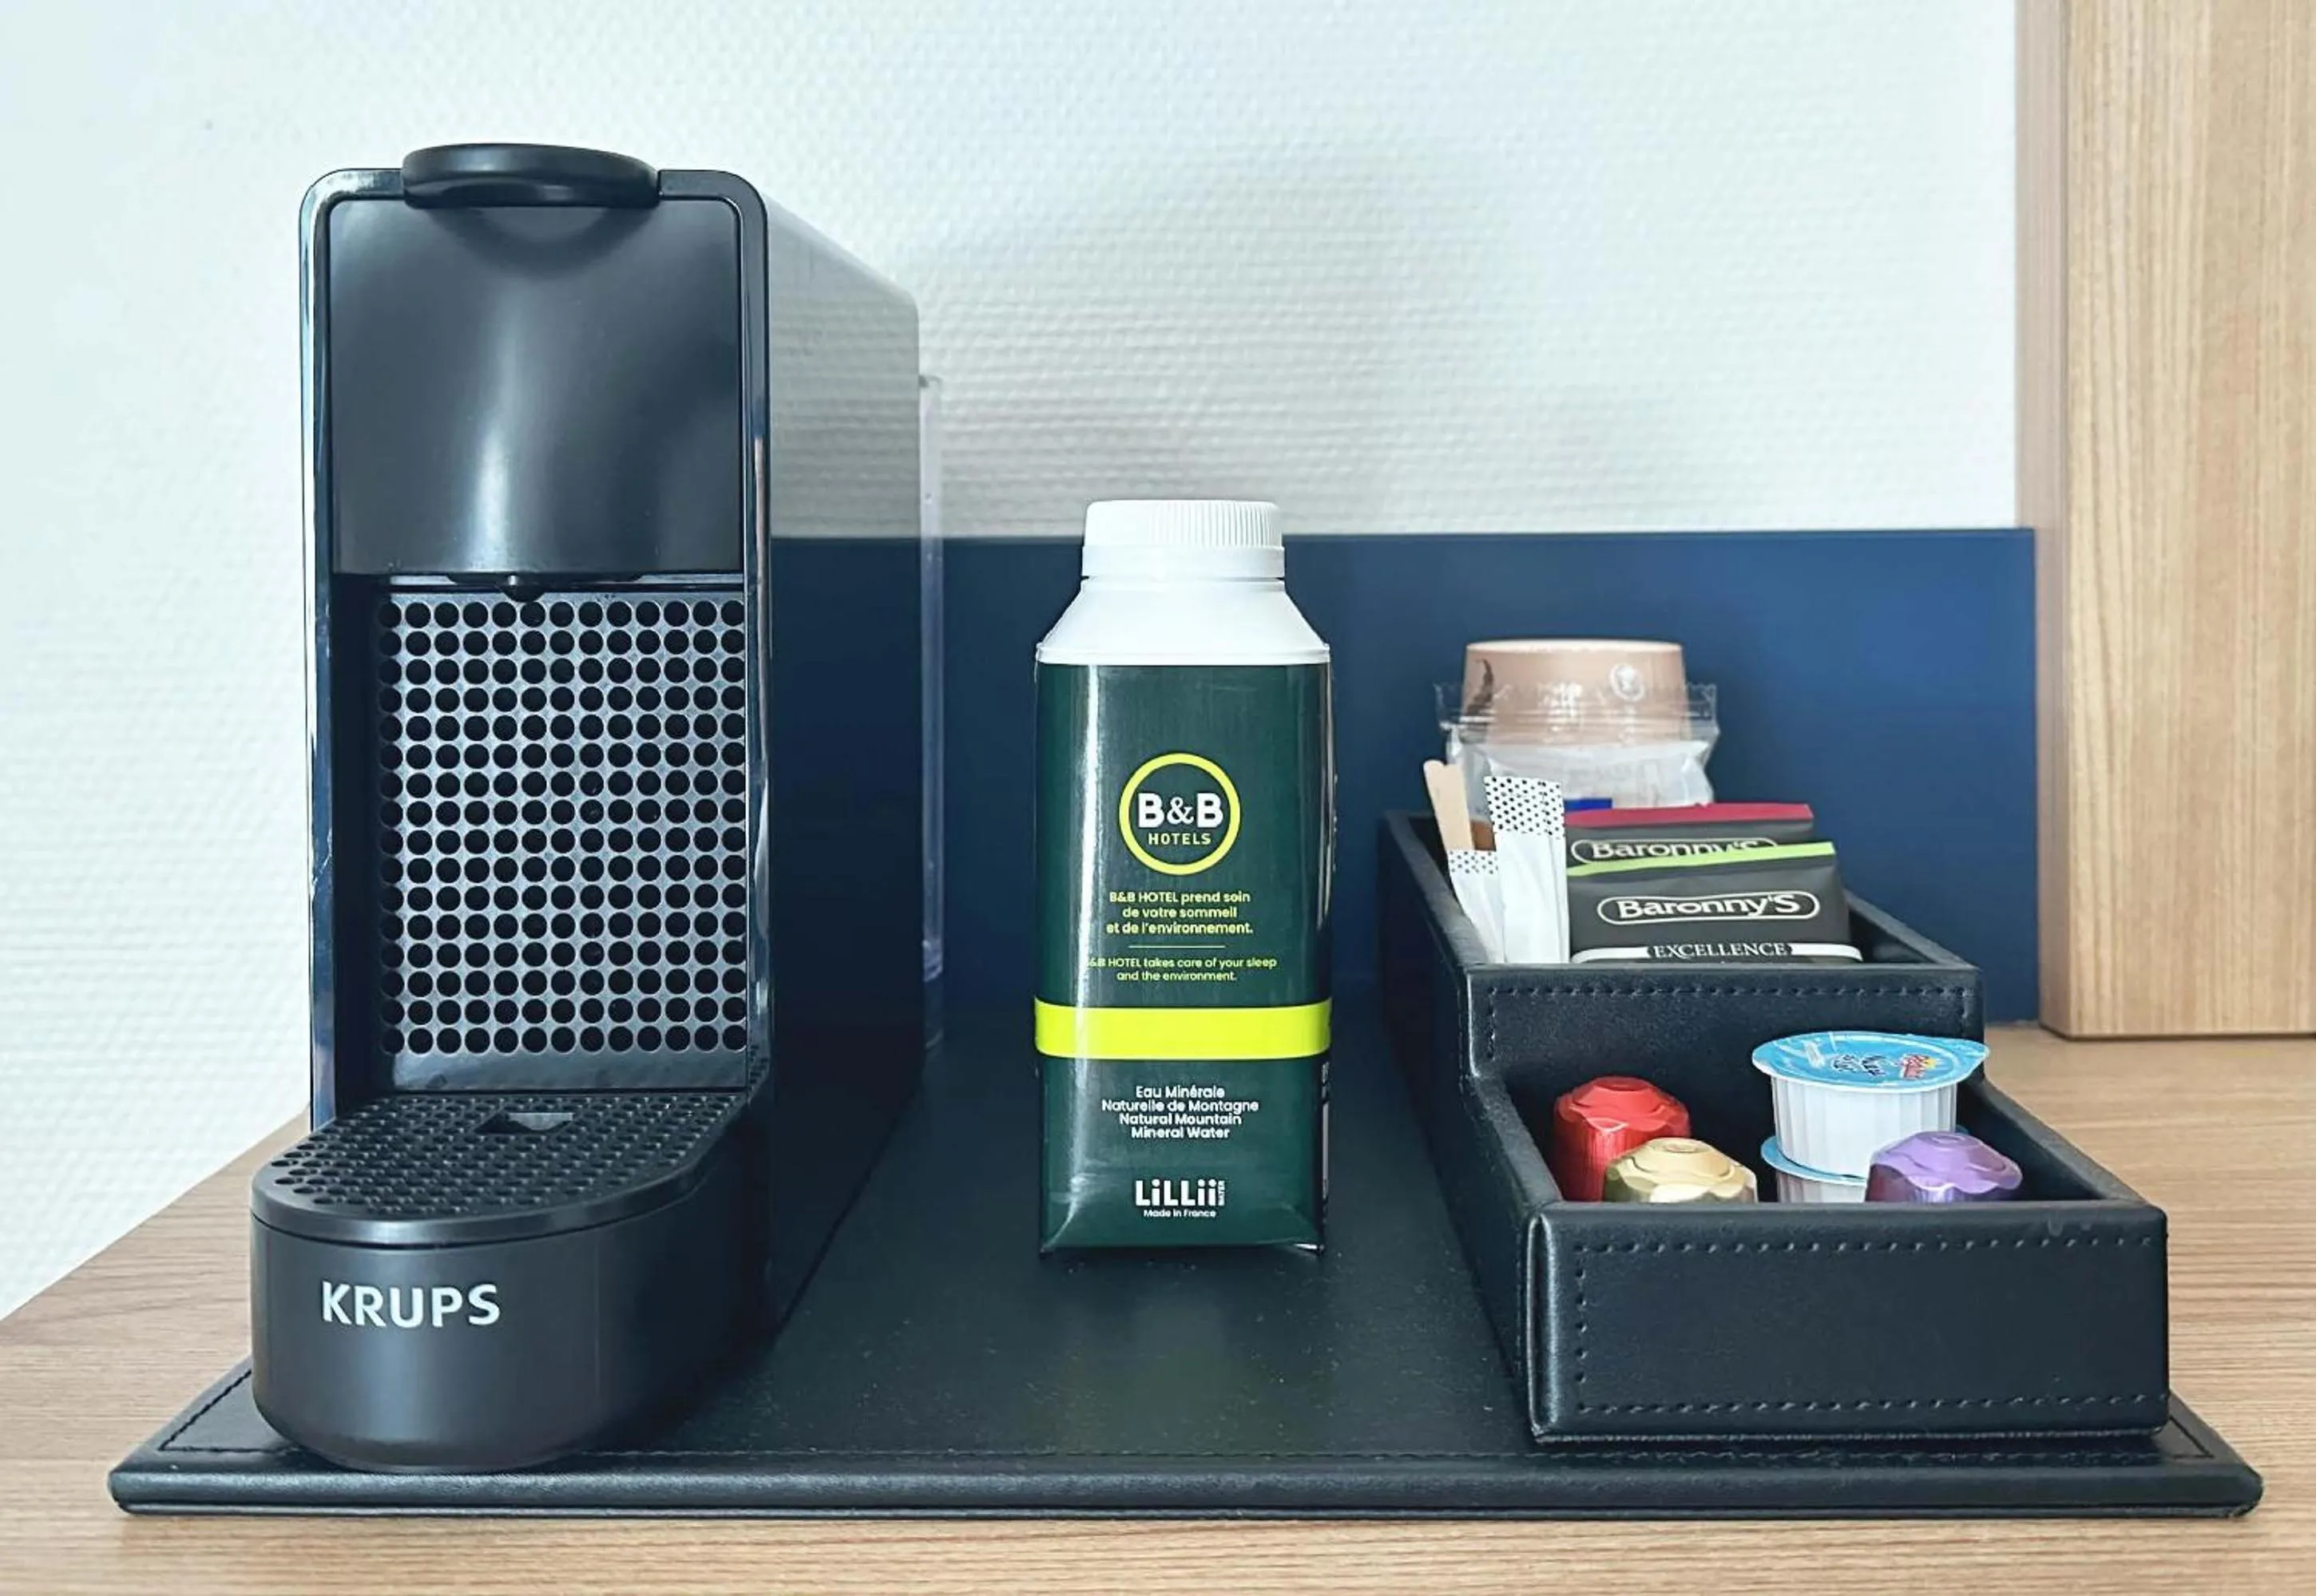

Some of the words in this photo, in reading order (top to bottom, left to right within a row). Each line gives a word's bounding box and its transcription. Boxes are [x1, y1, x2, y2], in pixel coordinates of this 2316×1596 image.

[1137, 792, 1224, 829] B&B
[1148, 832, 1212, 846] HOTELS
[1108, 891, 1136, 903] B&B
[1138, 891, 1178, 903] HOTEL
[1181, 890, 1219, 905] prend
[1223, 890, 1251, 903] soin
[1122, 907, 1140, 918] de
[1142, 908, 1177, 918] votre
[1179, 906, 1237, 918] sommeil
[1106, 923, 1120, 934] et
[1122, 922, 1139, 934] de
[1652, 942, 1787, 960] EXCELLENCE
[1085, 958, 1106, 968] &B
[1108, 958, 1142, 968] HOTEL
[1143, 957, 1176, 968] takes
[1176, 959, 1203, 968] care
[1204, 957, 1218, 968] of
[1219, 959, 1245, 971] your
[1246, 957, 1278, 970] sleep
[1116, 971, 1139, 981] and
[1141, 971, 1161, 981] the
[1162, 971, 1237, 981] environment.
[1135, 1086, 1162, 1099] Eau
[1165, 1084, 1225, 1099] Minérale
[1101, 1099, 1164, 1112] Naturelle
[1167, 1099, 1186, 1112] de
[1188, 1099, 1259, 1115] Montagne
[1119, 1112, 1172, 1125] Natural
[1175, 1112, 1243, 1125] Mountain
[1131, 1126, 1184, 1139] Mineral
[1187, 1127, 1231, 1139] Water
[1143, 1209, 1172, 1218] Made
[1172, 1208, 1182, 1218] in
[1184, 1209, 1217, 1218] France
[322, 1281, 502, 1329] KRUPS
